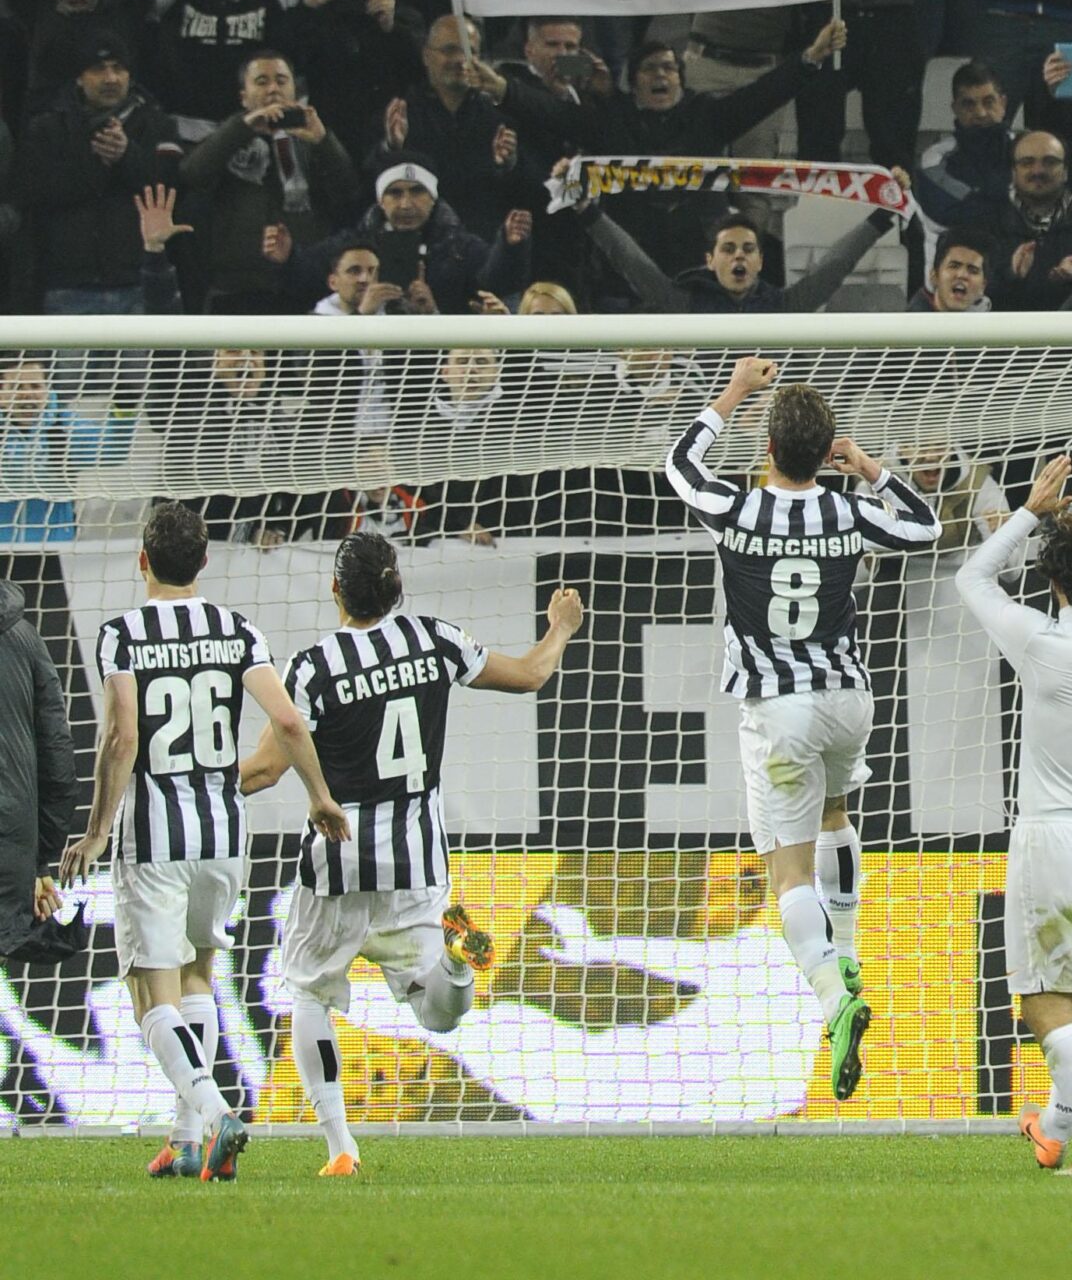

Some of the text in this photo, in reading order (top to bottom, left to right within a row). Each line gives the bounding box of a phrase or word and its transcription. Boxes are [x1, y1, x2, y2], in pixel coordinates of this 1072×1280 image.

[771, 169, 872, 202] AJAX
[723, 527, 863, 558] MARCHISIO
[768, 558, 822, 641] 8
[335, 656, 440, 705] CACERES
[145, 670, 237, 775] 26
[376, 696, 428, 794] 4
